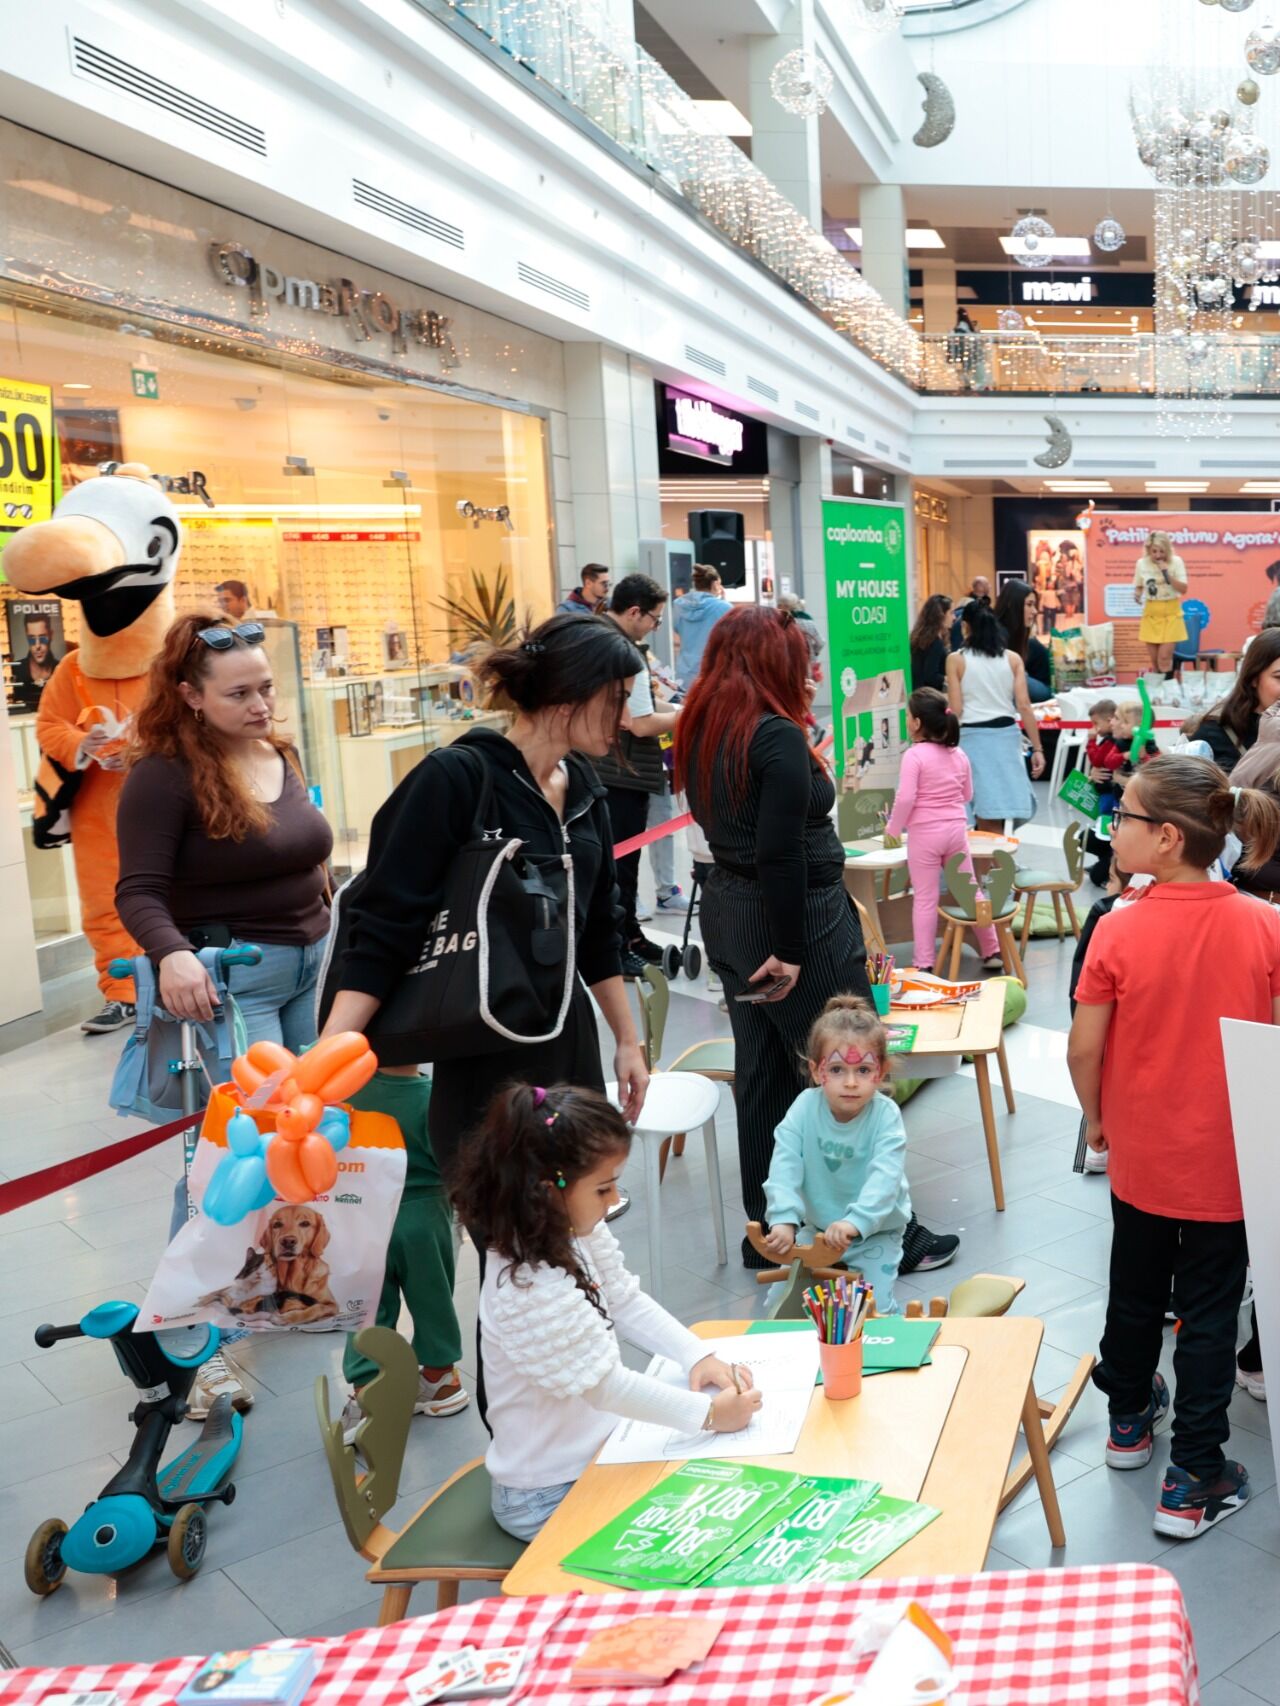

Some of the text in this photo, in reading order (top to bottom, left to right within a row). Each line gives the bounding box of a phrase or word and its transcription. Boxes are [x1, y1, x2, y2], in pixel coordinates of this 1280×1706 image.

[1022, 276, 1092, 302] mavi
[826, 523, 883, 546] caploonba
[1106, 528, 1150, 544] Patili
[1166, 527, 1218, 544] ostunu
[836, 579, 900, 599] MY HOUSE
[13, 603, 60, 615] POLICE
[851, 605, 887, 625] ODASI
[432, 930, 478, 957] BAG
